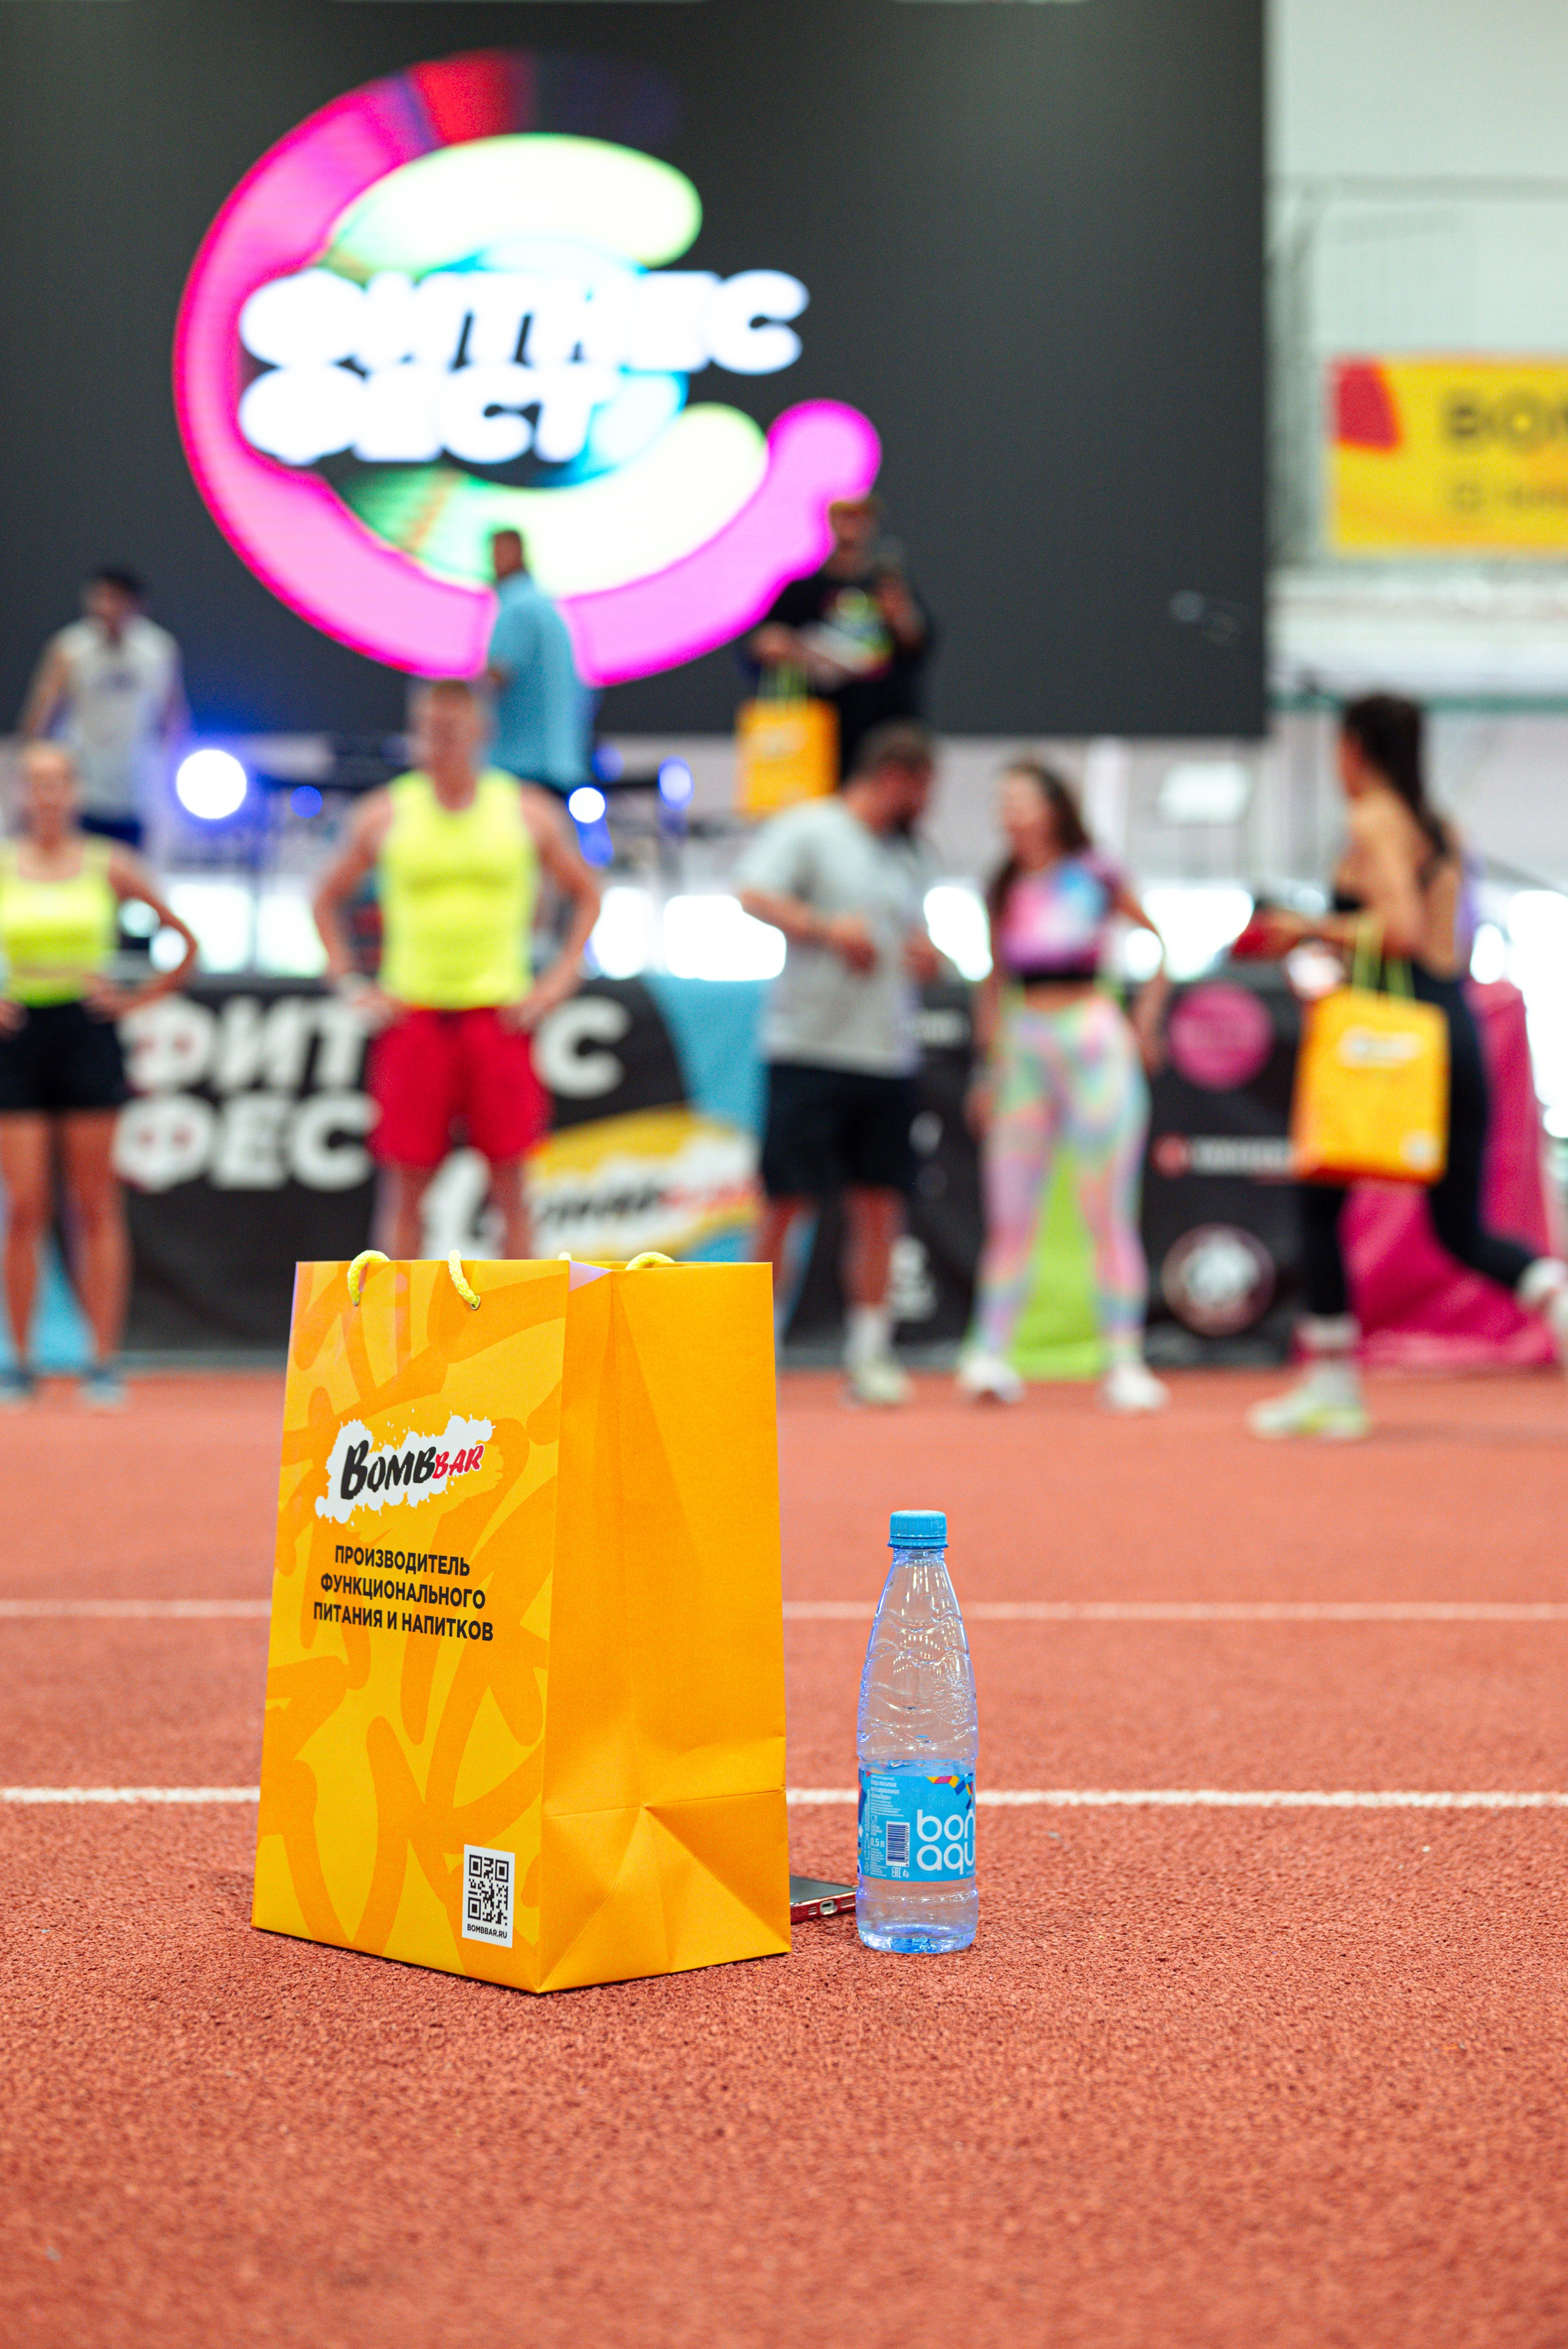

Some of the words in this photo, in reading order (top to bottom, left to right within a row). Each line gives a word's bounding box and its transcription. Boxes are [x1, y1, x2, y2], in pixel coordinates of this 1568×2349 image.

[120, 994, 631, 1098] ФИТС
[335, 1545, 470, 1576] ПРОИЗВОДИТЕЛЬ
[320, 1573, 486, 1610] ФУНКЦИОНАЛЬНОГО
[313, 1602, 383, 1628] ПИТАНИЯ
[387, 1611, 398, 1630] И
[402, 1613, 494, 1641] НАПИТКОВ
[916, 1809, 975, 1842] bon
[467, 1923, 508, 1939] BOMBBAR.RU
